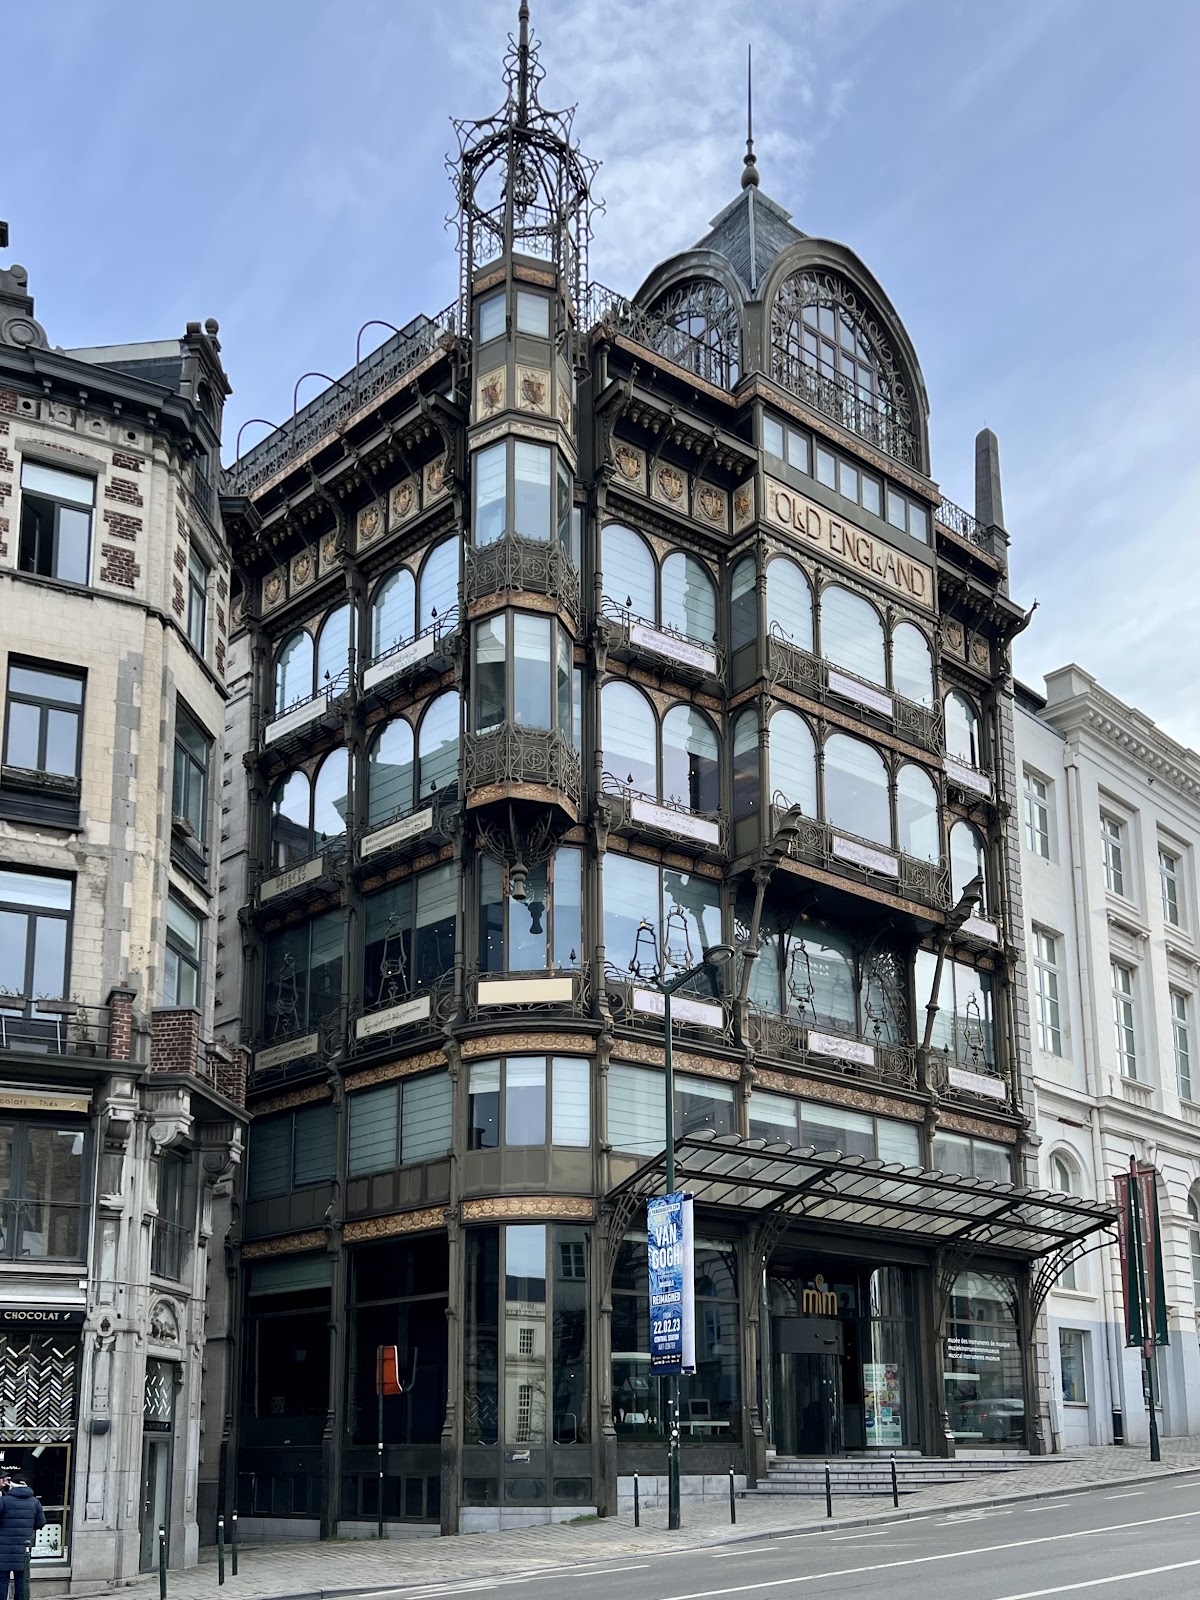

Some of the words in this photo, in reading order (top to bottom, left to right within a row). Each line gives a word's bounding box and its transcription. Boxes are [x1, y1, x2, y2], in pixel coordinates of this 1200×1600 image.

[775, 492, 821, 540] OLD
[829, 518, 925, 597] ENGLAND
[655, 1223, 677, 1247] VAN
[652, 1244, 680, 1270] GOGH
[652, 1291, 681, 1305] REIMAGINED
[802, 1273, 838, 1316] mim
[4, 1311, 60, 1320] CHOCOLAT
[653, 1318, 681, 1335] 22.02.23
